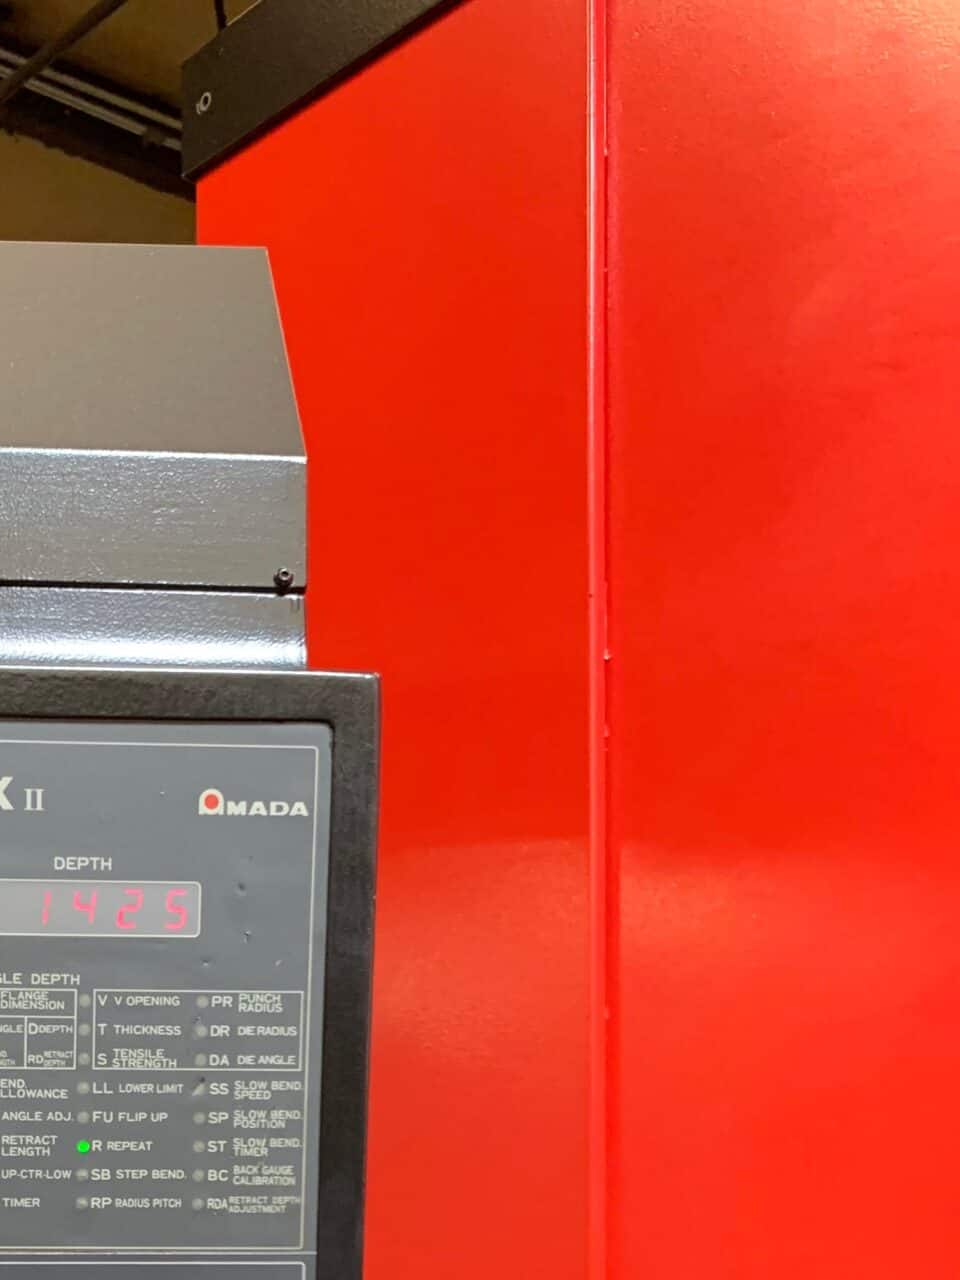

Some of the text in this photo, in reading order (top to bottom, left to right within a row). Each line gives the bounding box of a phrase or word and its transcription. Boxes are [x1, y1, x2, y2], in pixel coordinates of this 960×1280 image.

[198, 788, 309, 816] AMADA
[53, 856, 113, 871] DEPTH
[31, 973, 80, 986] DEPTH
[0, 991, 49, 1000] FLANGE
[97, 995, 108, 1006] V
[126, 996, 181, 1006] OPENING
[239, 993, 281, 1003] PUNCH
[0, 1000, 65, 1010] DIMENSION
[211, 995, 233, 1008] PR
[238, 1003, 283, 1013] RADIUS
[28, 1023, 74, 1035] D DEPTH
[97, 1023, 181, 1036] T THICKNESS
[210, 1025, 297, 1037] DR DIE RADIUS
[112, 1048, 165, 1058] TENSILE
[28, 1054, 44, 1064] RD
[97, 1053, 107, 1065] S
[112, 1058, 177, 1068] STRENGTH
[209, 1054, 296, 1066] DA DIE ANGLE
[92, 1082, 184, 1094] LL LOWER LIMIT
[209, 1083, 229, 1095] SS
[234, 1081, 267, 1090] SLOW
[234, 1090, 272, 1100] SPEED
[1, 1112, 43, 1121] ANGLE
[92, 1111, 169, 1123] FU FLIP UP
[208, 1112, 229, 1124] SP
[233, 1110, 267, 1120] SLOW
[233, 1120, 286, 1129] POSITION
[1, 1135, 58, 1145] RETRACT
[92, 1140, 153, 1151] R REPEAT
[233, 1138, 266, 1147] SLOW
[1, 1146, 51, 1156] LENGTH
[207, 1140, 228, 1152] ST
[1, 1169, 72, 1180] UP-CTR-LOW
[91, 1169, 111, 1180] SB
[116, 1169, 148, 1179] STEP
[207, 1169, 229, 1181] BC
[233, 1165, 295, 1175] BACK GAUGE
[233, 1175, 296, 1185] CALIBRATION
[3, 1197, 40, 1207] TIMER
[91, 1197, 182, 1208] RP RADIUS PITCH
[207, 1198, 228, 1210] RDA
